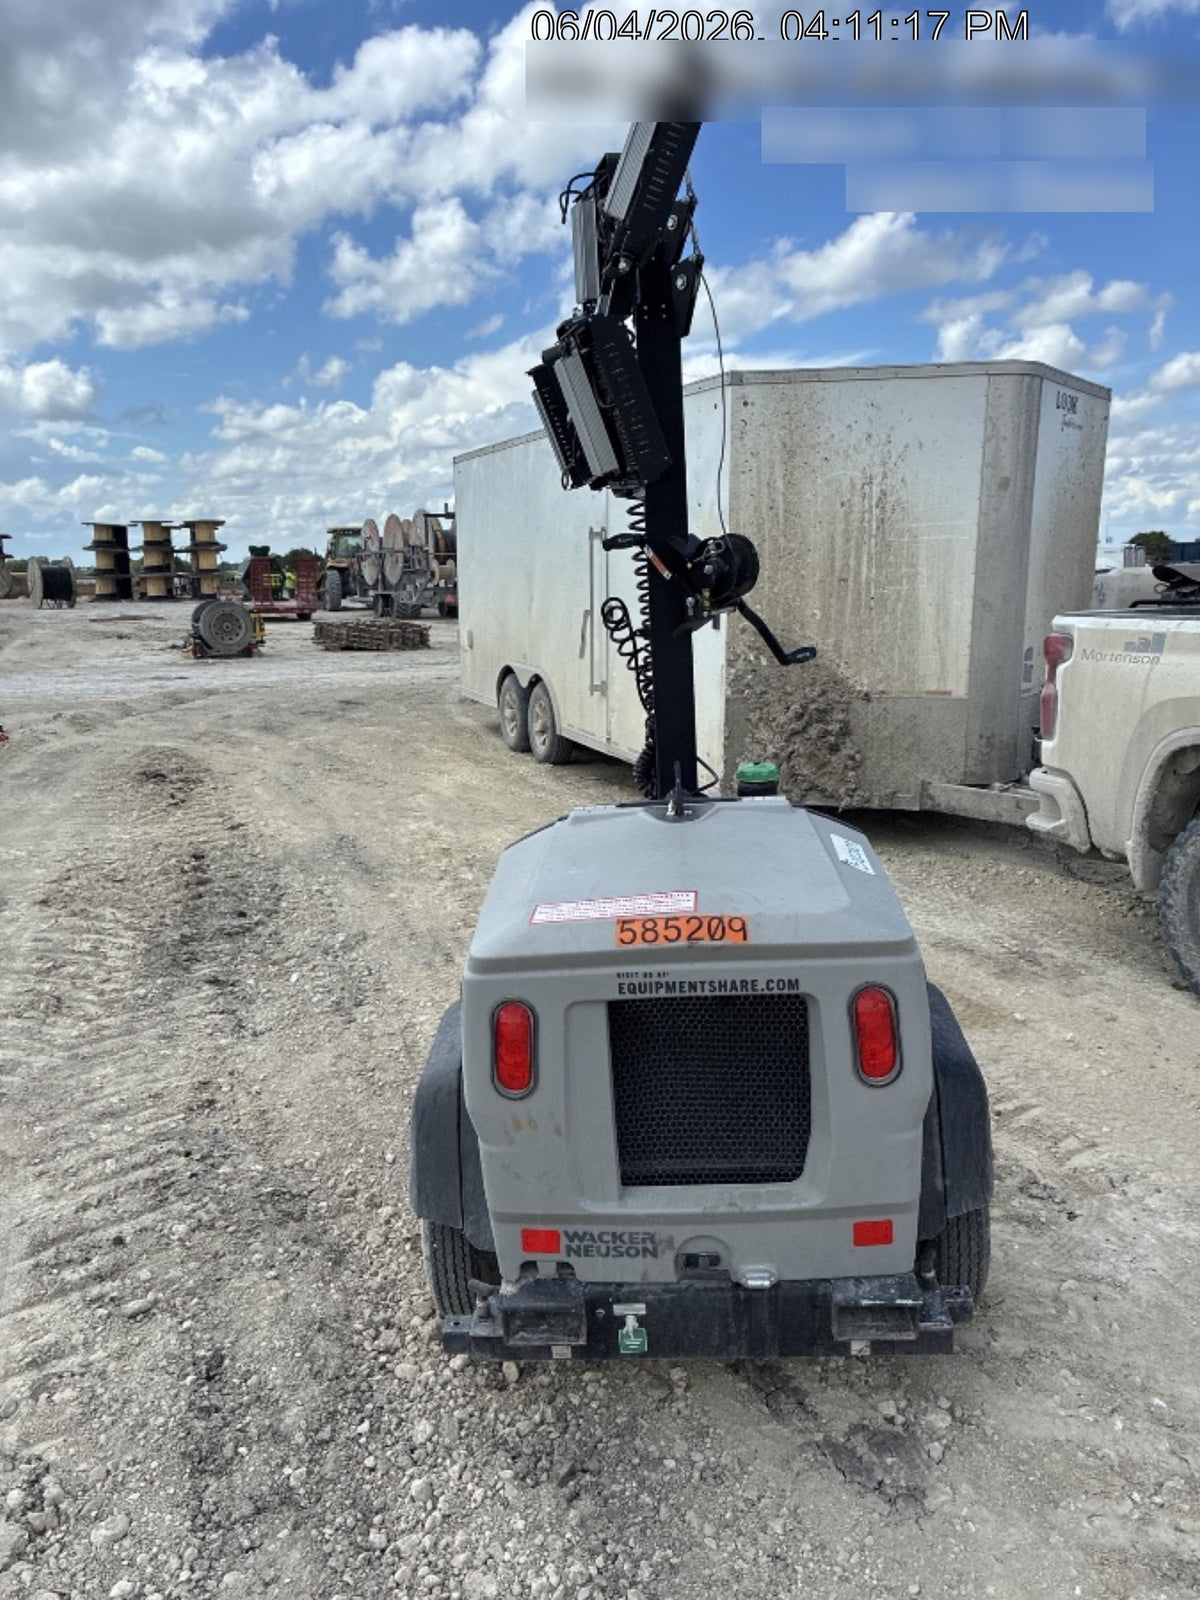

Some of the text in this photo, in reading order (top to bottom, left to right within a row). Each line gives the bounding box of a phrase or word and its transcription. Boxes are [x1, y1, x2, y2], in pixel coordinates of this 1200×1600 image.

[1080, 648, 1161, 665] Mortenson
[619, 916, 747, 944] 585209
[617, 978, 800, 995] EQUIPMENTSHARE.COM
[563, 1230, 657, 1245] WACKER
[565, 1244, 659, 1258] NEUSON
